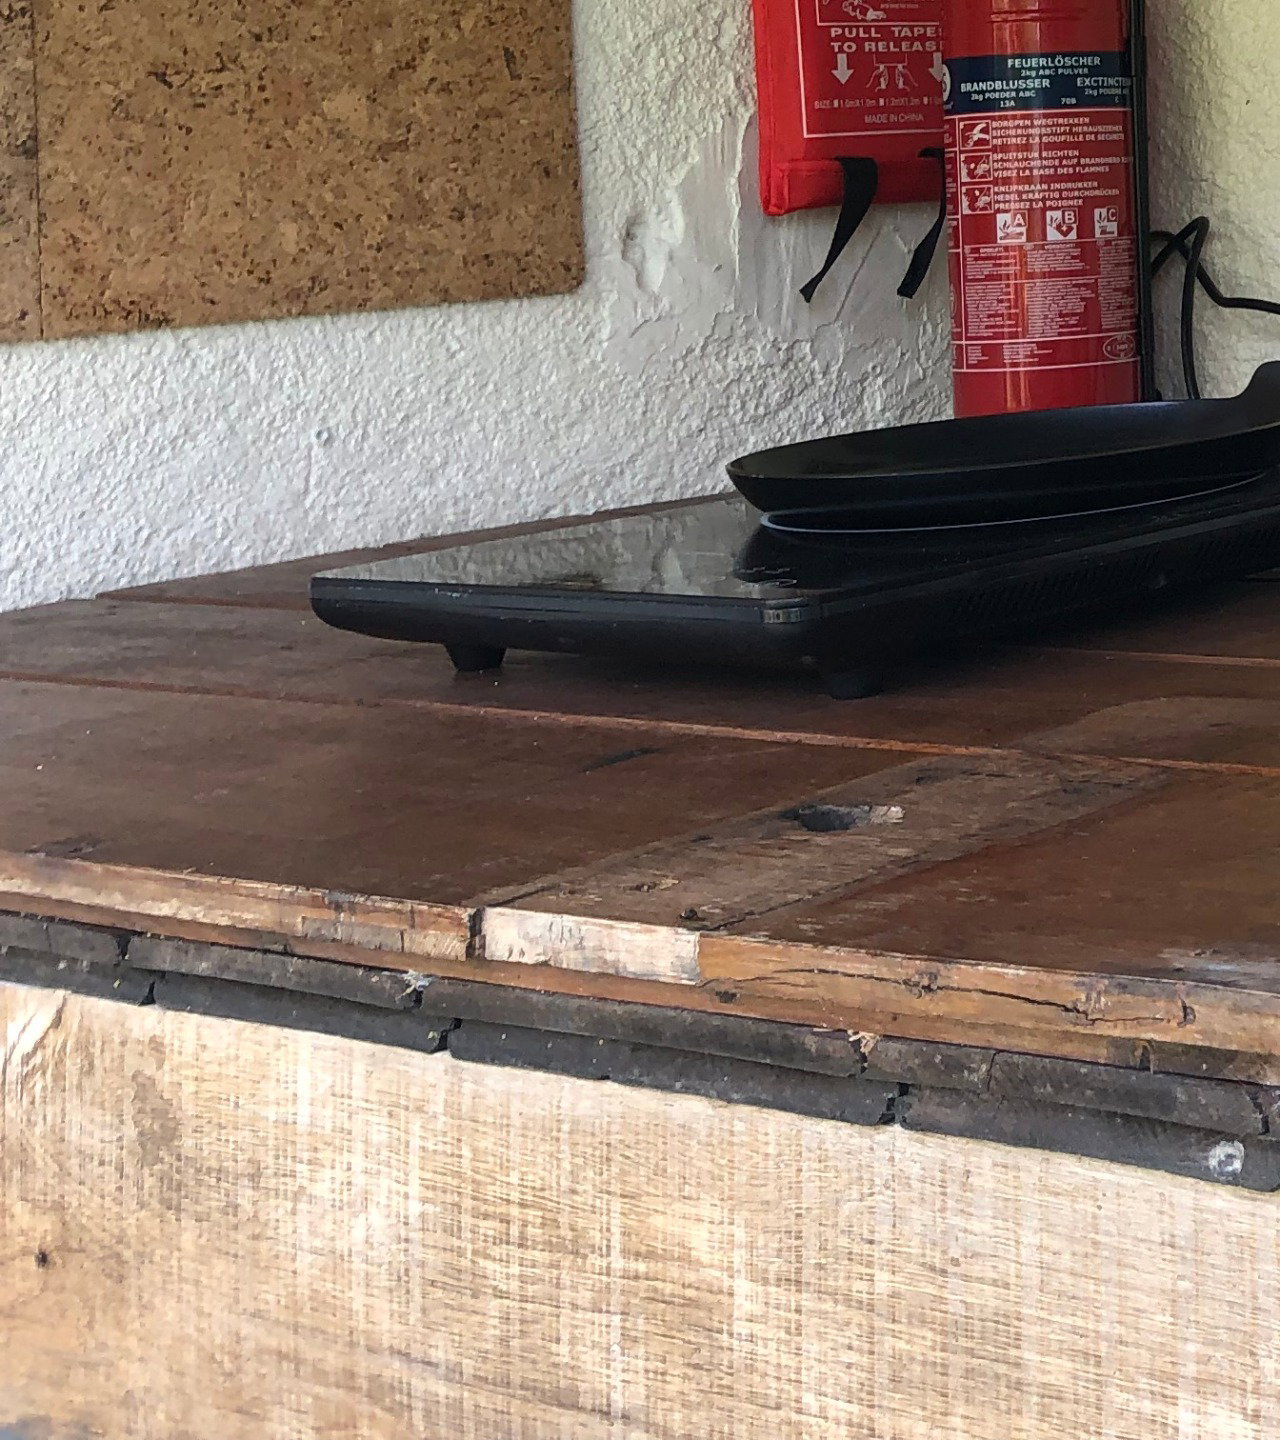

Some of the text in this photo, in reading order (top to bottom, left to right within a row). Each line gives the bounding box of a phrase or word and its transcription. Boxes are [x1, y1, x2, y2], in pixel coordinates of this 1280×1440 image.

[830, 27, 881, 38] PULL
[830, 40, 942, 52] TO RELEAS
[1007, 54, 1101, 69] FEUERLÖSCHER
[1021, 67, 1089, 78] 2kg ABC PULVER
[960, 78, 1051, 93] BRANDBLUSSER
[985, 91, 1017, 99] POEDER
[1018, 90, 1036, 98] ABC
[864, 112, 924, 123] MADE IN CHINA
[1042, 149, 1079, 158] RICHTEN
[1061, 158, 1078, 166] AUF
[993, 169, 1018, 178] VISEZ
[1020, 168, 1031, 176] LA
[1032, 167, 1055, 176] BASE
[1057, 166, 1074, 174] DES
[994, 201, 1030, 210] PRESSEZ
[1032, 200, 1044, 209] LA
[1013, 213, 1026, 227] A
[1064, 211, 1075, 224] B
[1108, 208, 1116, 221] C
